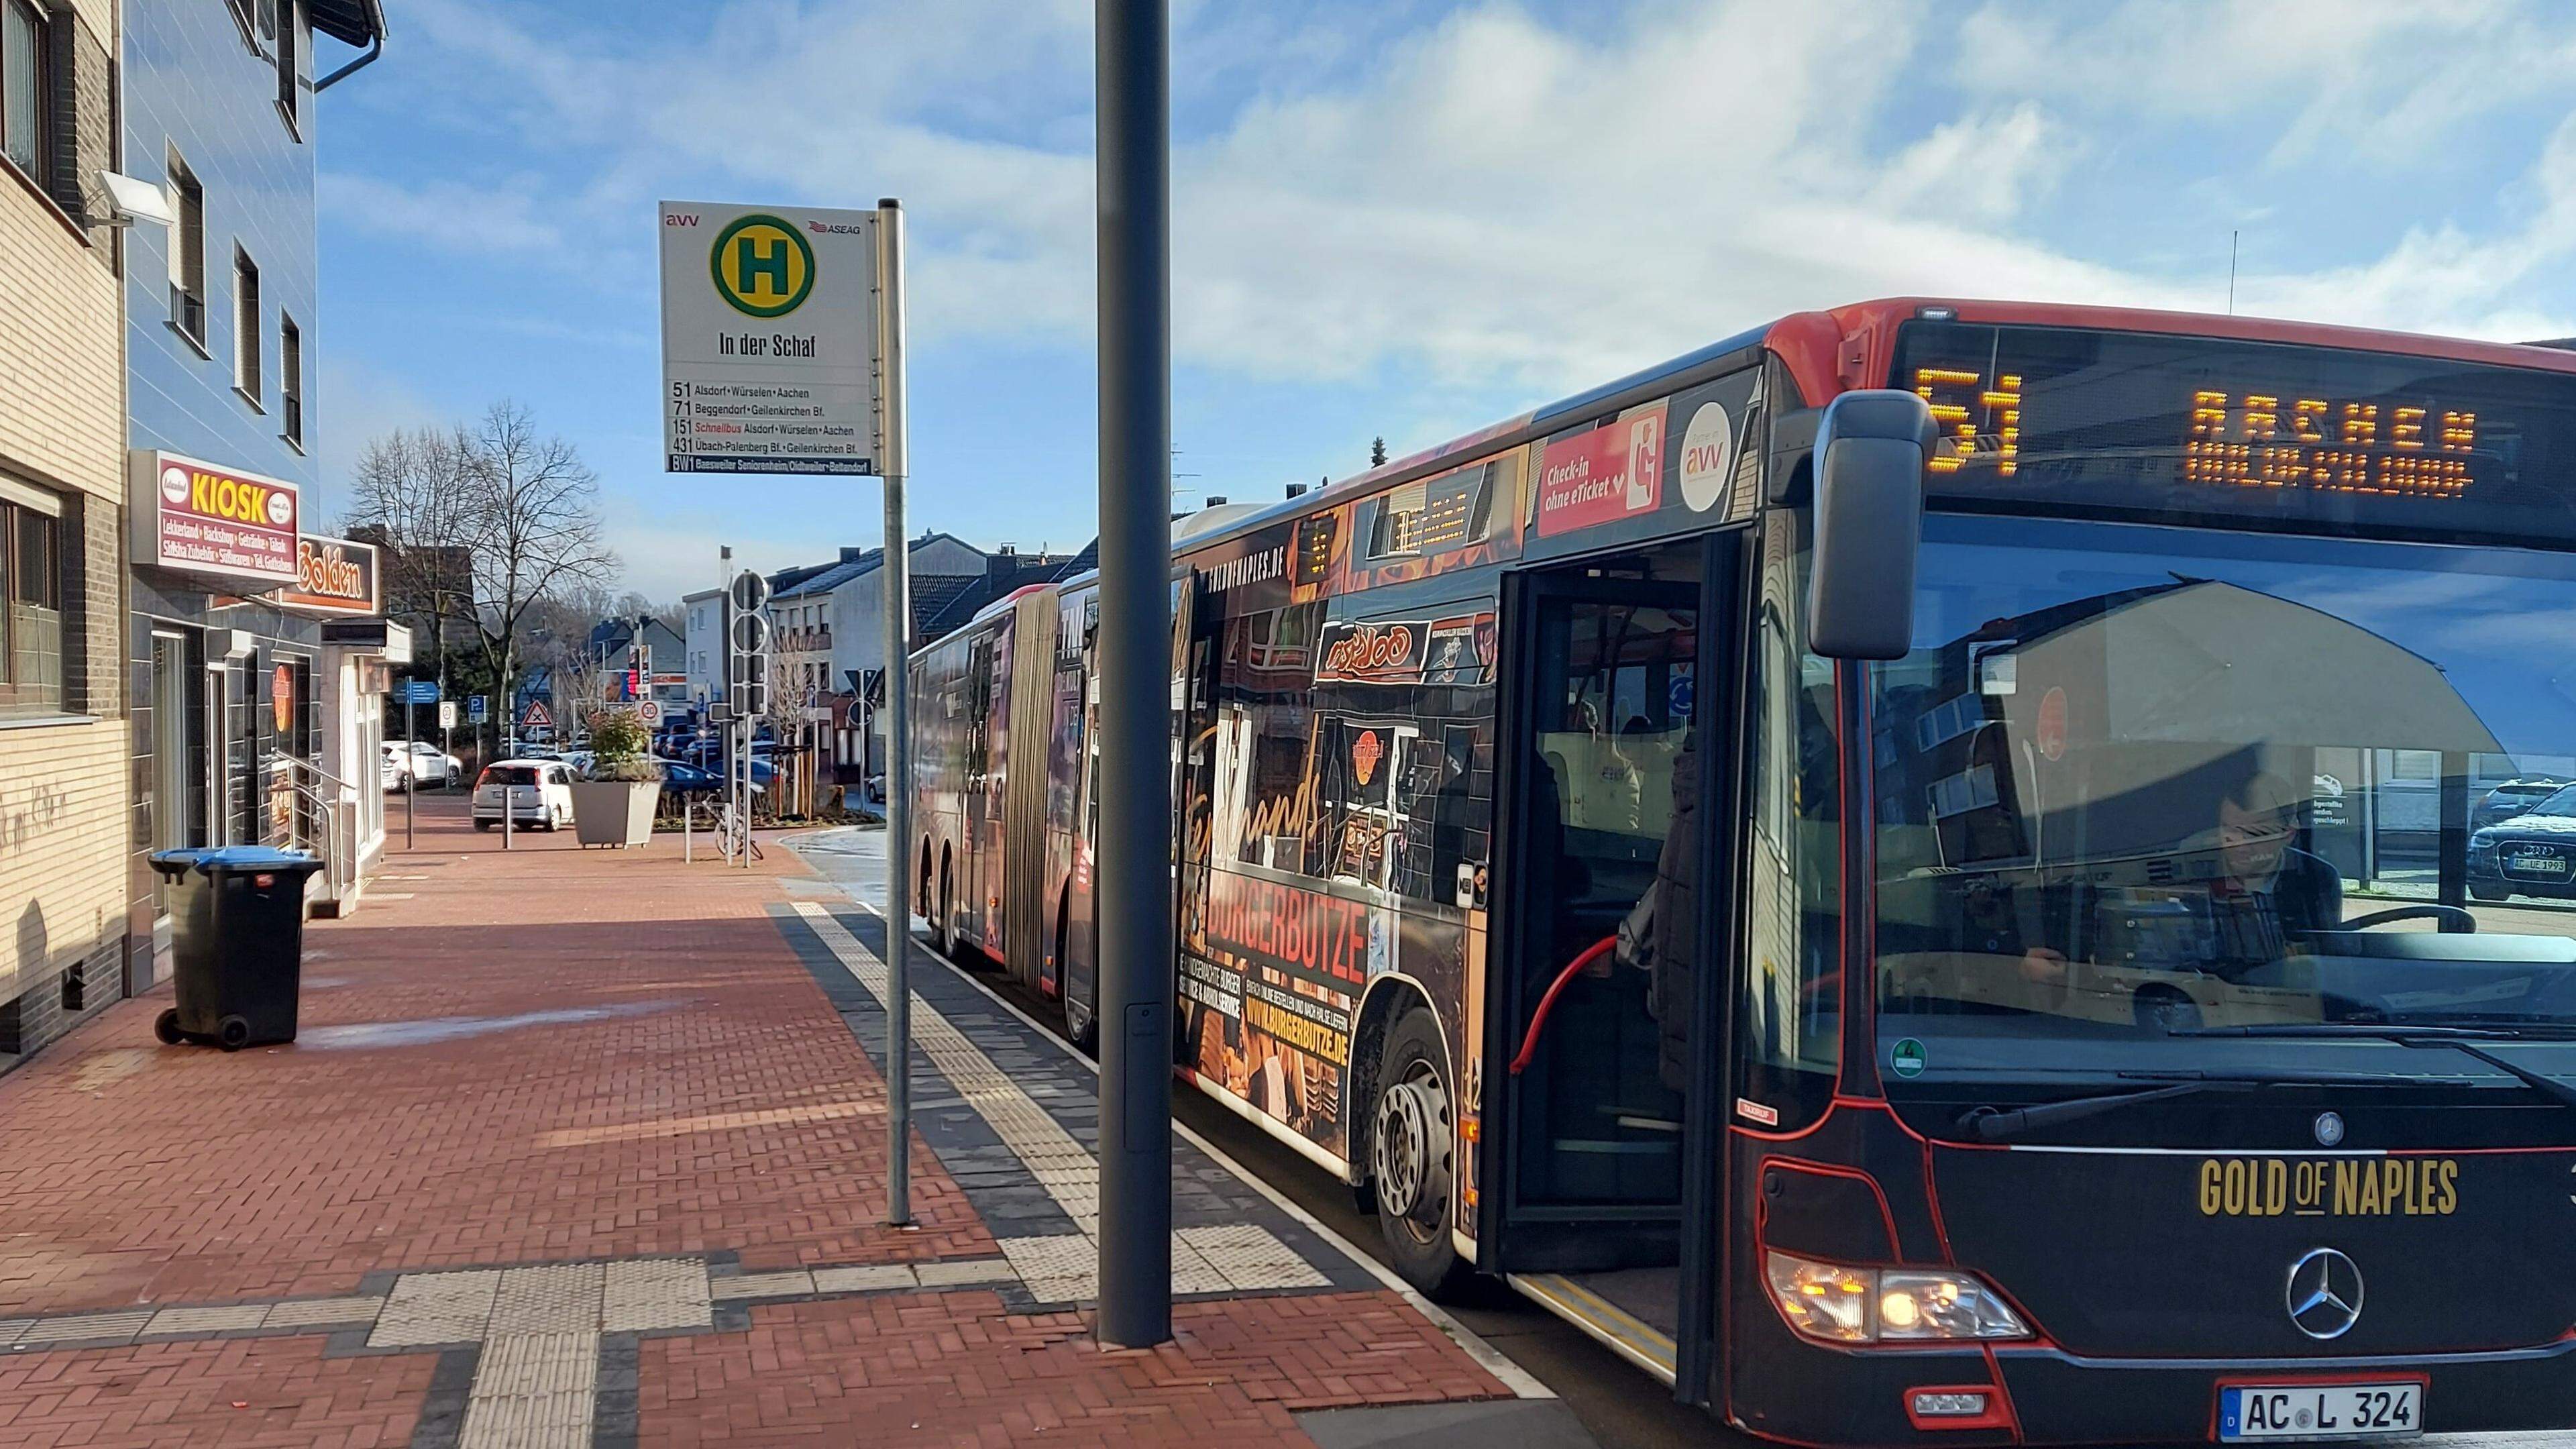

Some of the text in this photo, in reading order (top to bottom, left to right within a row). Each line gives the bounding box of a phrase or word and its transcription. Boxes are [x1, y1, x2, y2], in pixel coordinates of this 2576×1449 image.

[665, 214, 699, 227] avv
[827, 225, 861, 235] ASEAG
[737, 236, 789, 296] H
[719, 332, 816, 358] In der Schaf
[673, 382, 809, 398] 51 Alsdorf Würselen Aachen
[674, 400, 690, 416] 71
[695, 404, 746, 417] Beggendorf
[751, 405, 810, 417] Geilenkirchen
[1916, 368, 2023, 476] 51
[2193, 390, 2476, 452] AACHEN
[673, 419, 854, 436] 151 Schnellbus Alsdorf Würselen Aachen
[673, 437, 692, 453] 431
[695, 438, 767, 454] Übach-Palenberg
[787, 442, 844, 453] Geilenkirchen
[1686, 441, 1724, 475] avv
[673, 456, 694, 472] BW1
[1547, 455, 1589, 486] Check-in
[191, 472, 268, 525] KIOSK
[1546, 476, 1610, 512] ohne eTicket
[162, 517, 199, 539] Lekkerland
[203, 525, 234, 547] Backshop
[471, 698, 480, 712] P
[645, 706, 655, 715] 30
[2542, 861, 2565, 871] 1993
[1208, 877, 1366, 984] BURGERBUTZE
[1246, 994, 1348, 1067] WWW.BURGERBUTZE.DE
[1904, 1040, 1915, 1057] 4
[2200, 1159, 2459, 1216] GOLD OF NAPLES
[2226, 1391, 2410, 1430] D AC L 324
